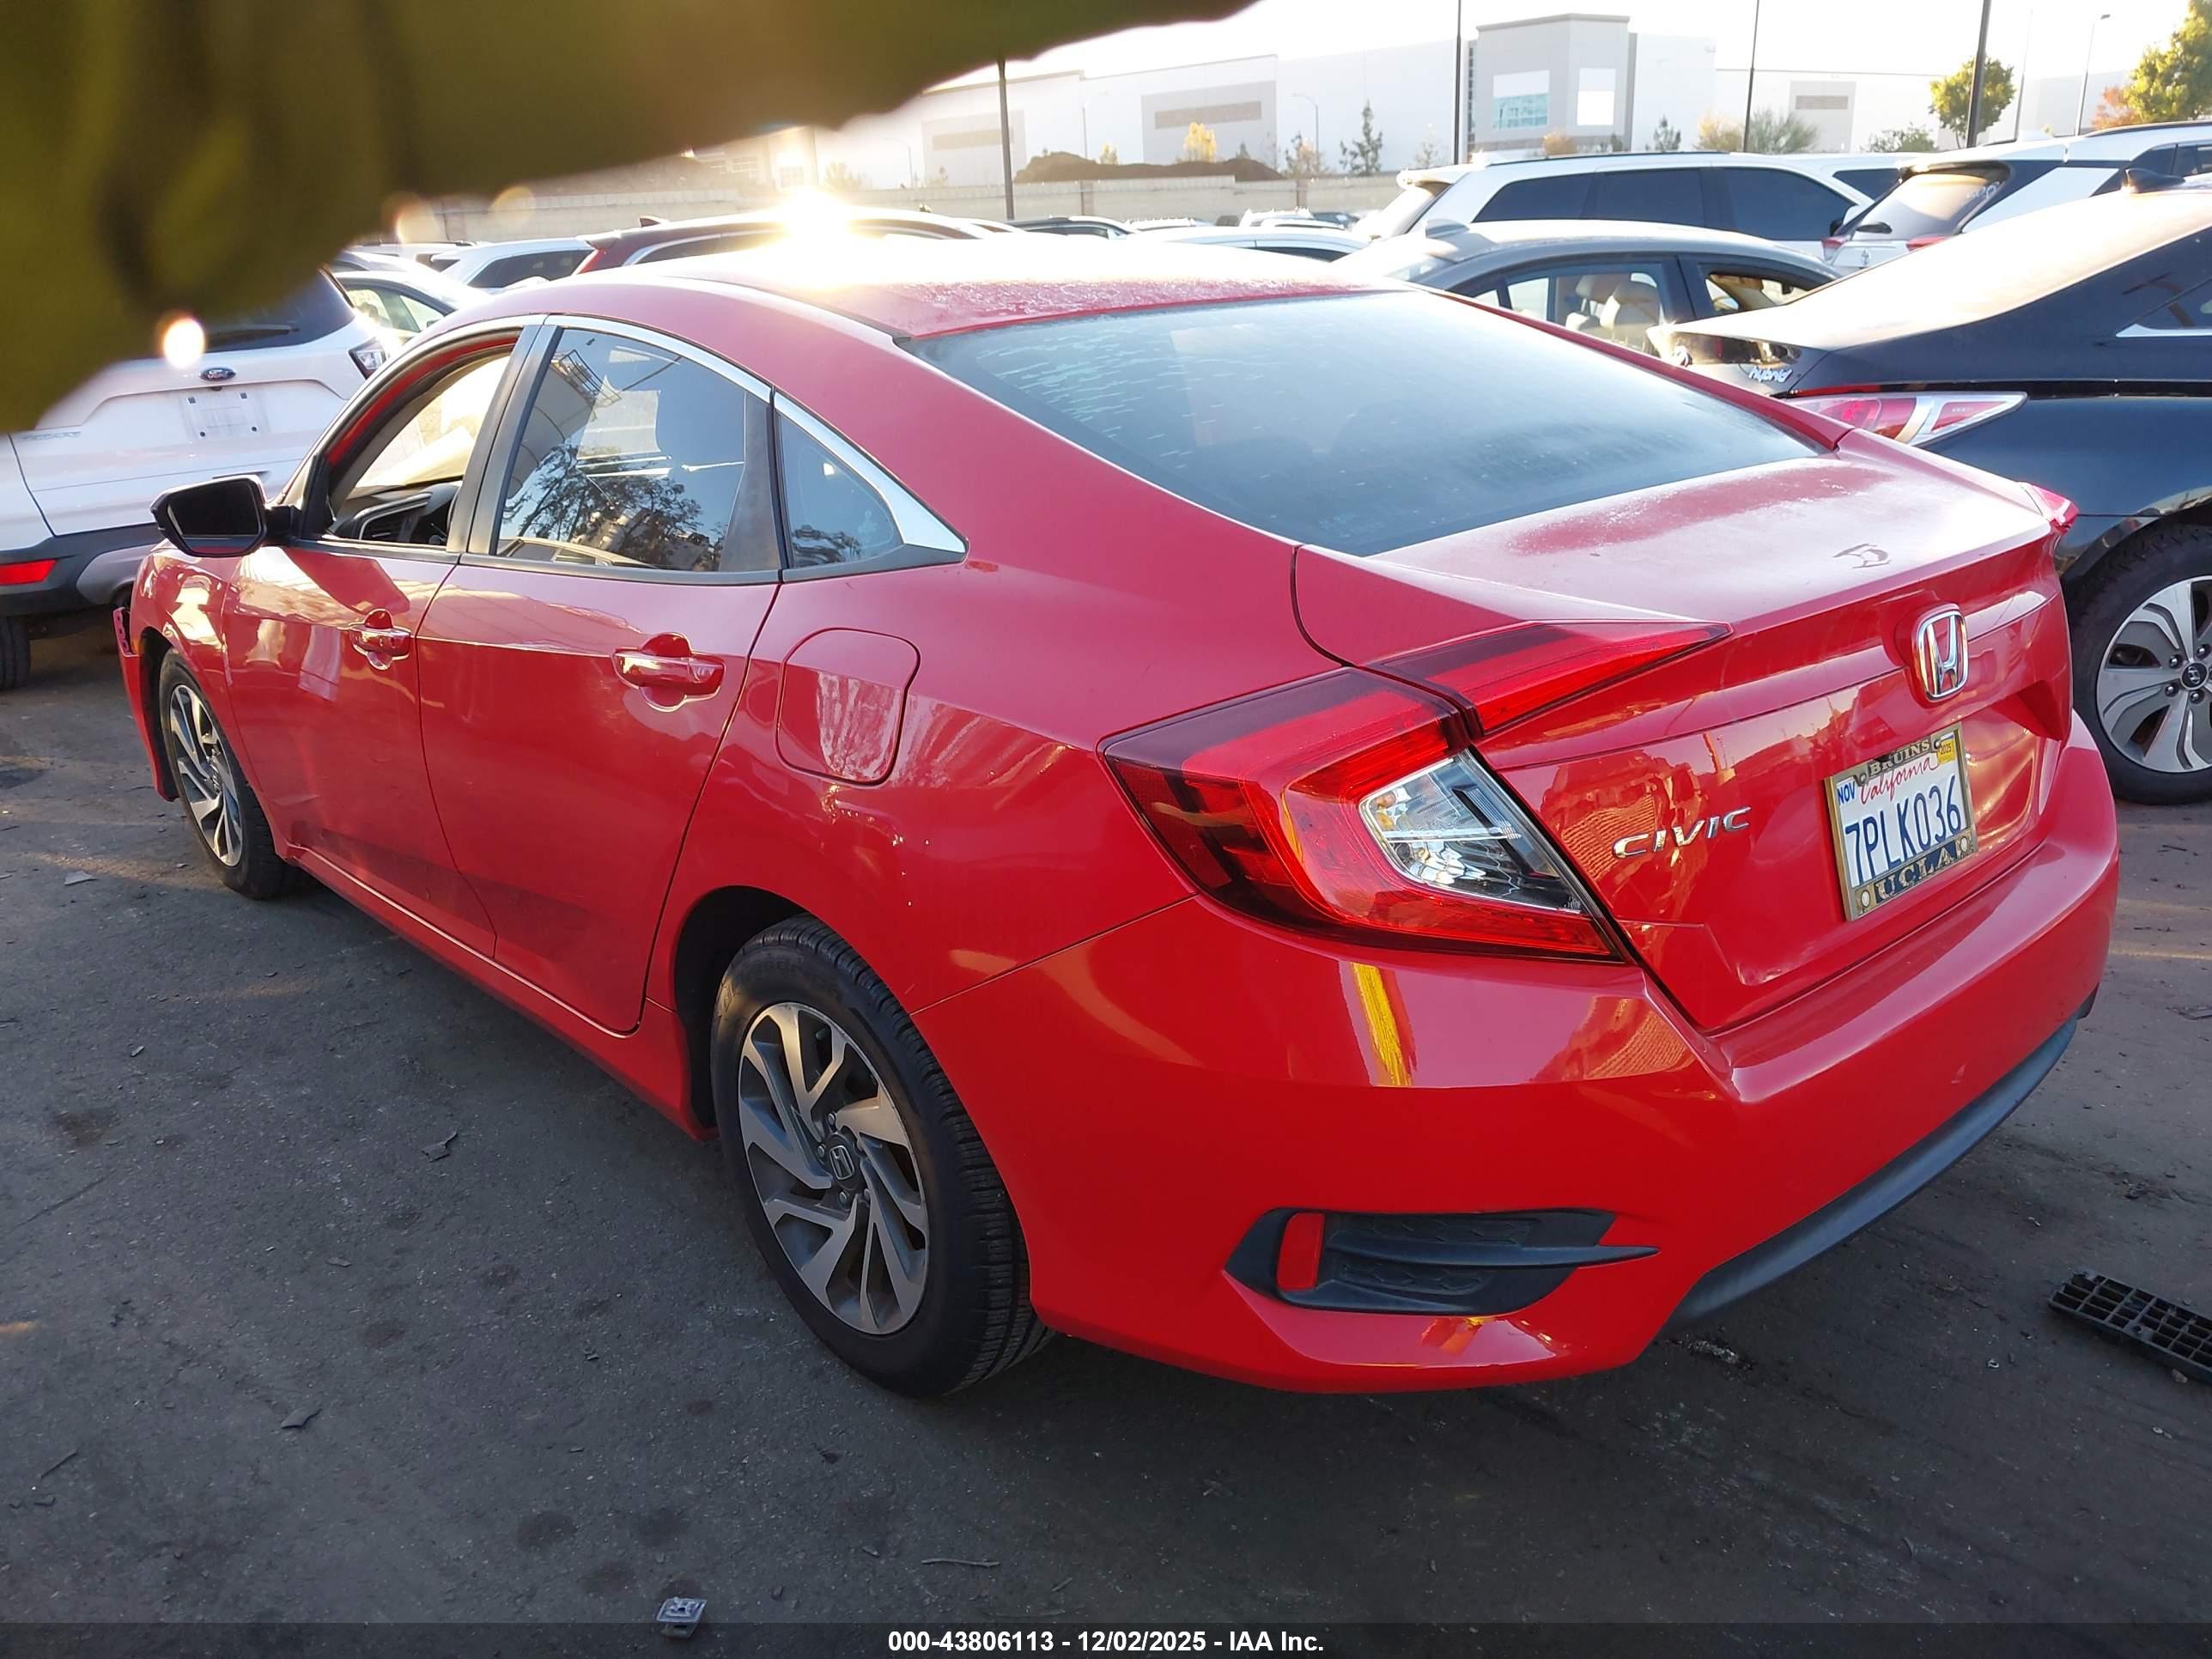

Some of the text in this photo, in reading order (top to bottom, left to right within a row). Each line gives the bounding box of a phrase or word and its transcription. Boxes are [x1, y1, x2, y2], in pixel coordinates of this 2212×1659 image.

[1748, 365, 1793, 383] hybrid
[1861, 756, 1938, 805] California
[1869, 739, 1930, 775] BRUINS
[1837, 781, 1856, 805] NOV
[1613, 806, 1752, 859] CIVIC
[1844, 775, 1961, 886] 7PLK036
[1875, 847, 1954, 899] UCLA
